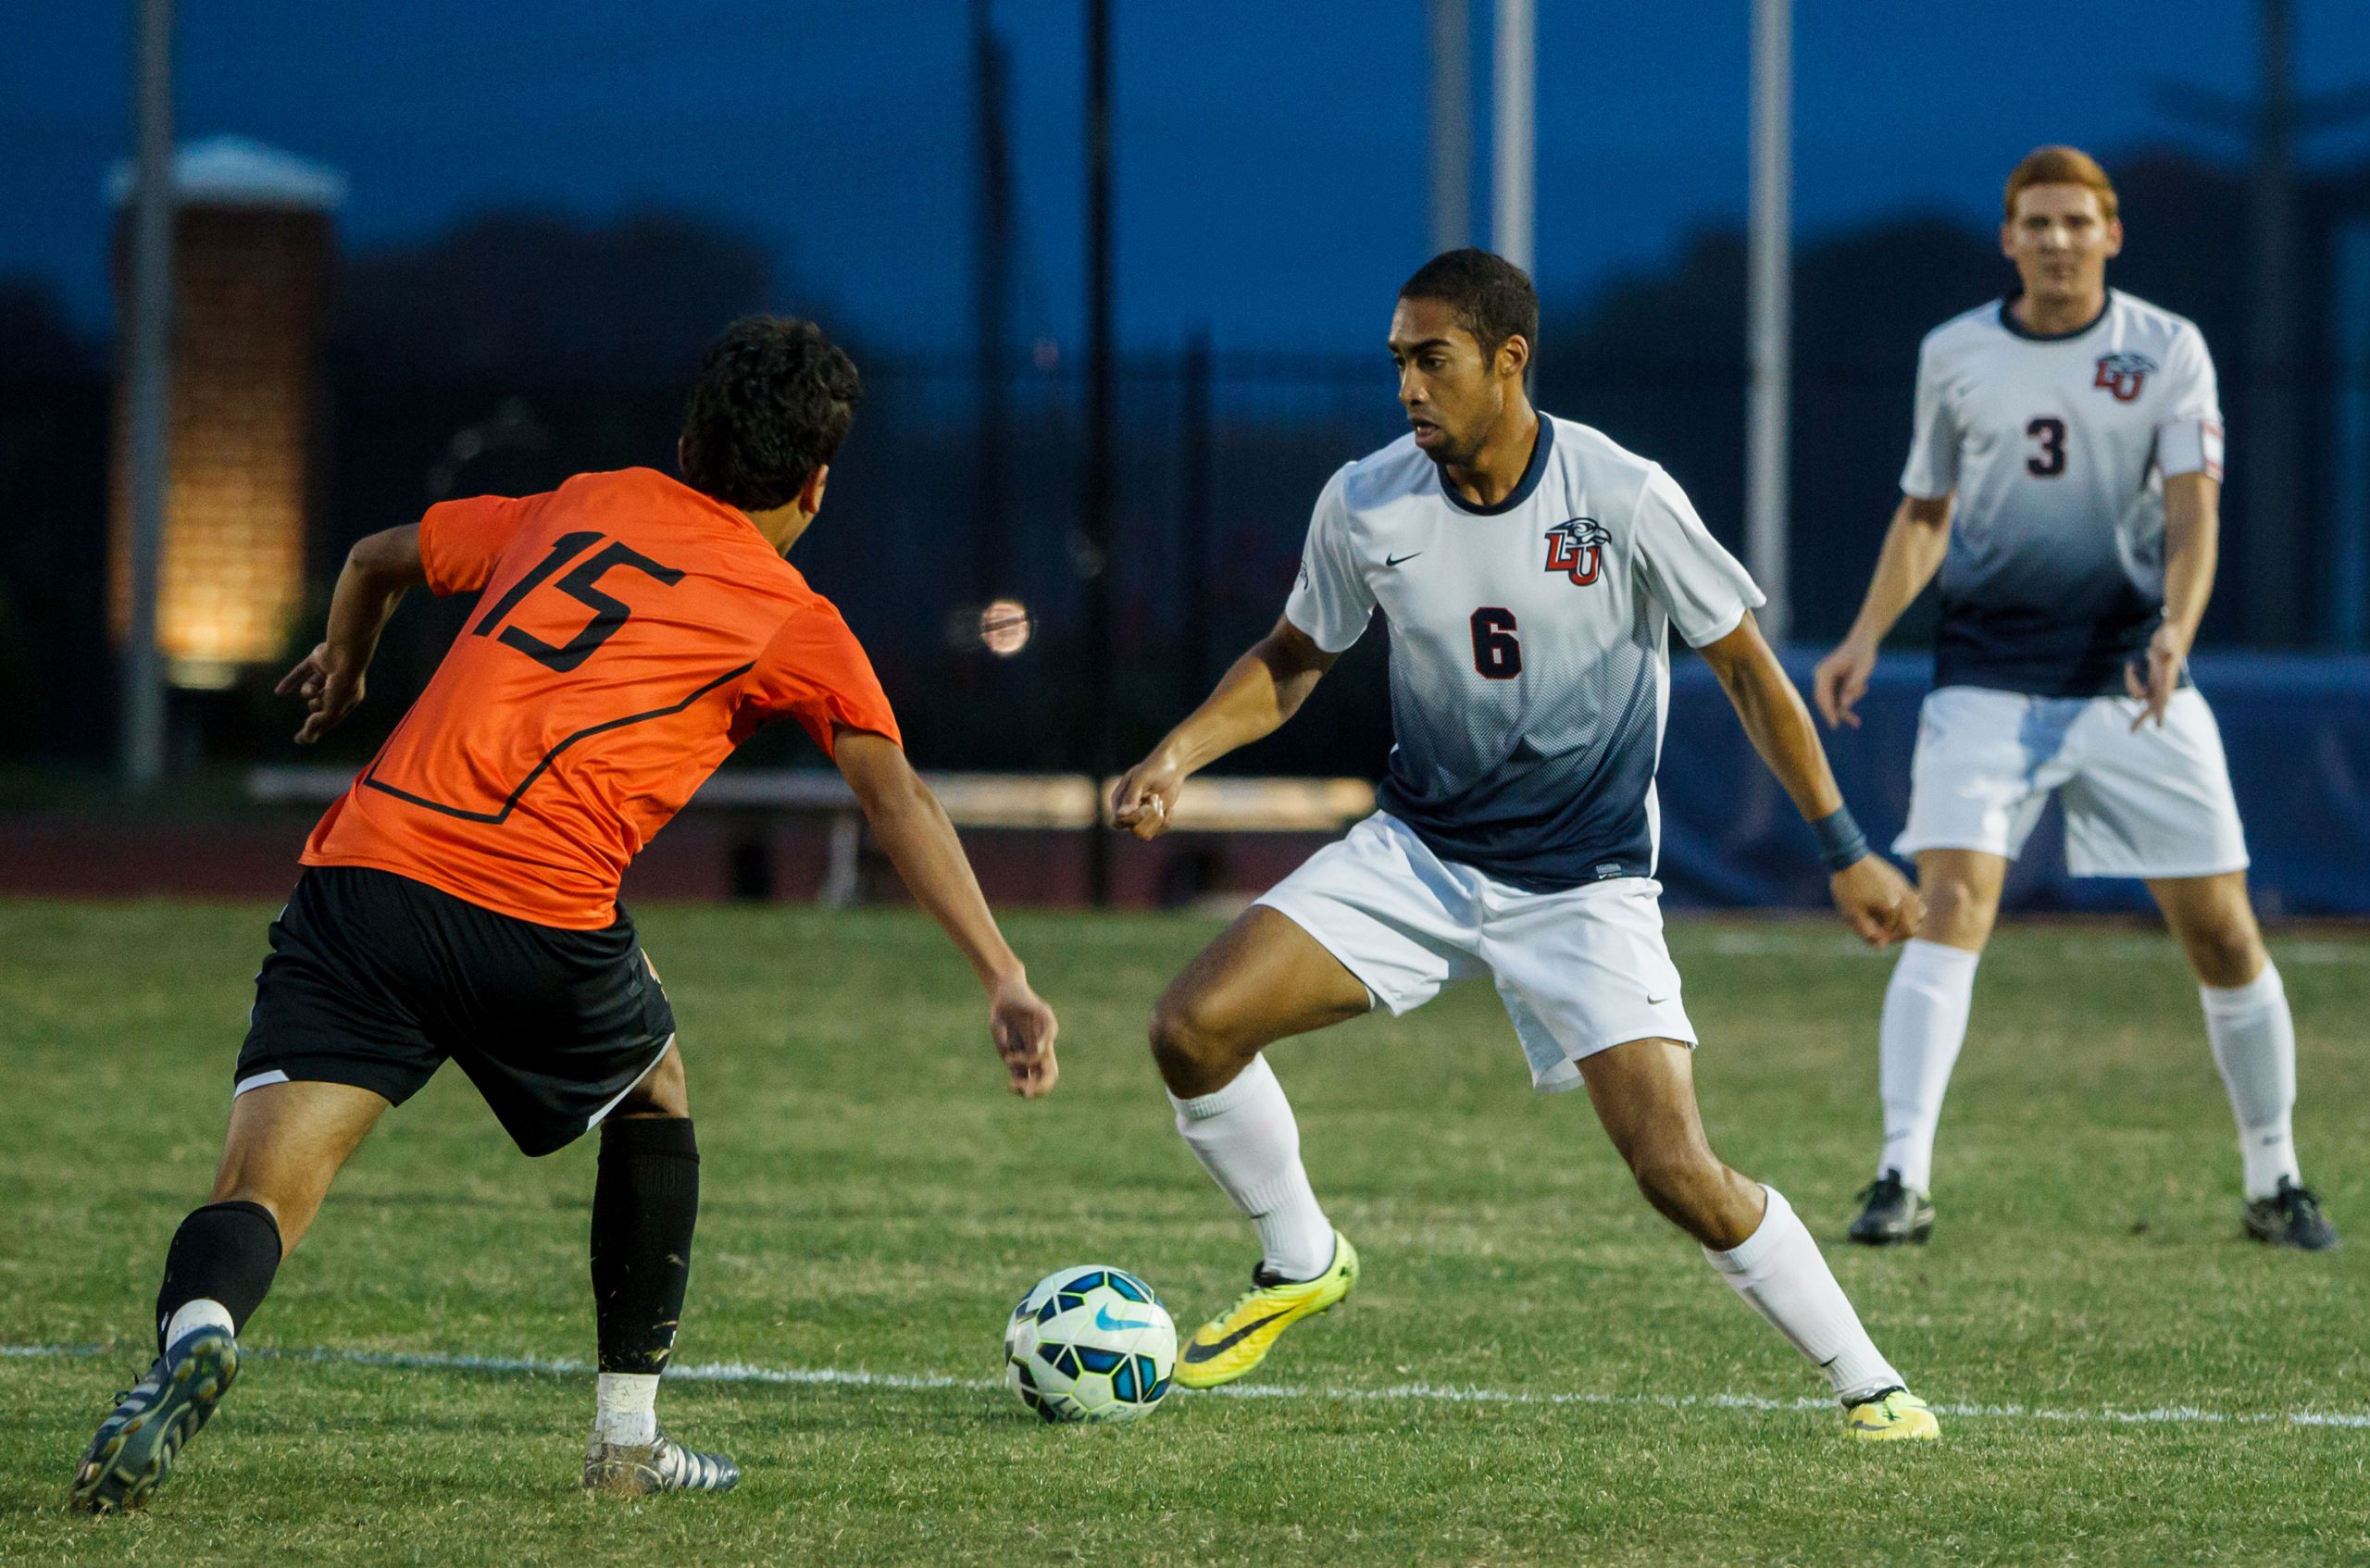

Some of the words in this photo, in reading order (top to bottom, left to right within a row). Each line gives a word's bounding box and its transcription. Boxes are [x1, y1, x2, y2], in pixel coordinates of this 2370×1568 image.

[2092, 359, 2145, 404] LU
[2026, 416, 2068, 479] 3
[1544, 531, 1602, 587] LU
[471, 530, 687, 674] 15
[1469, 606, 1522, 679] 6
